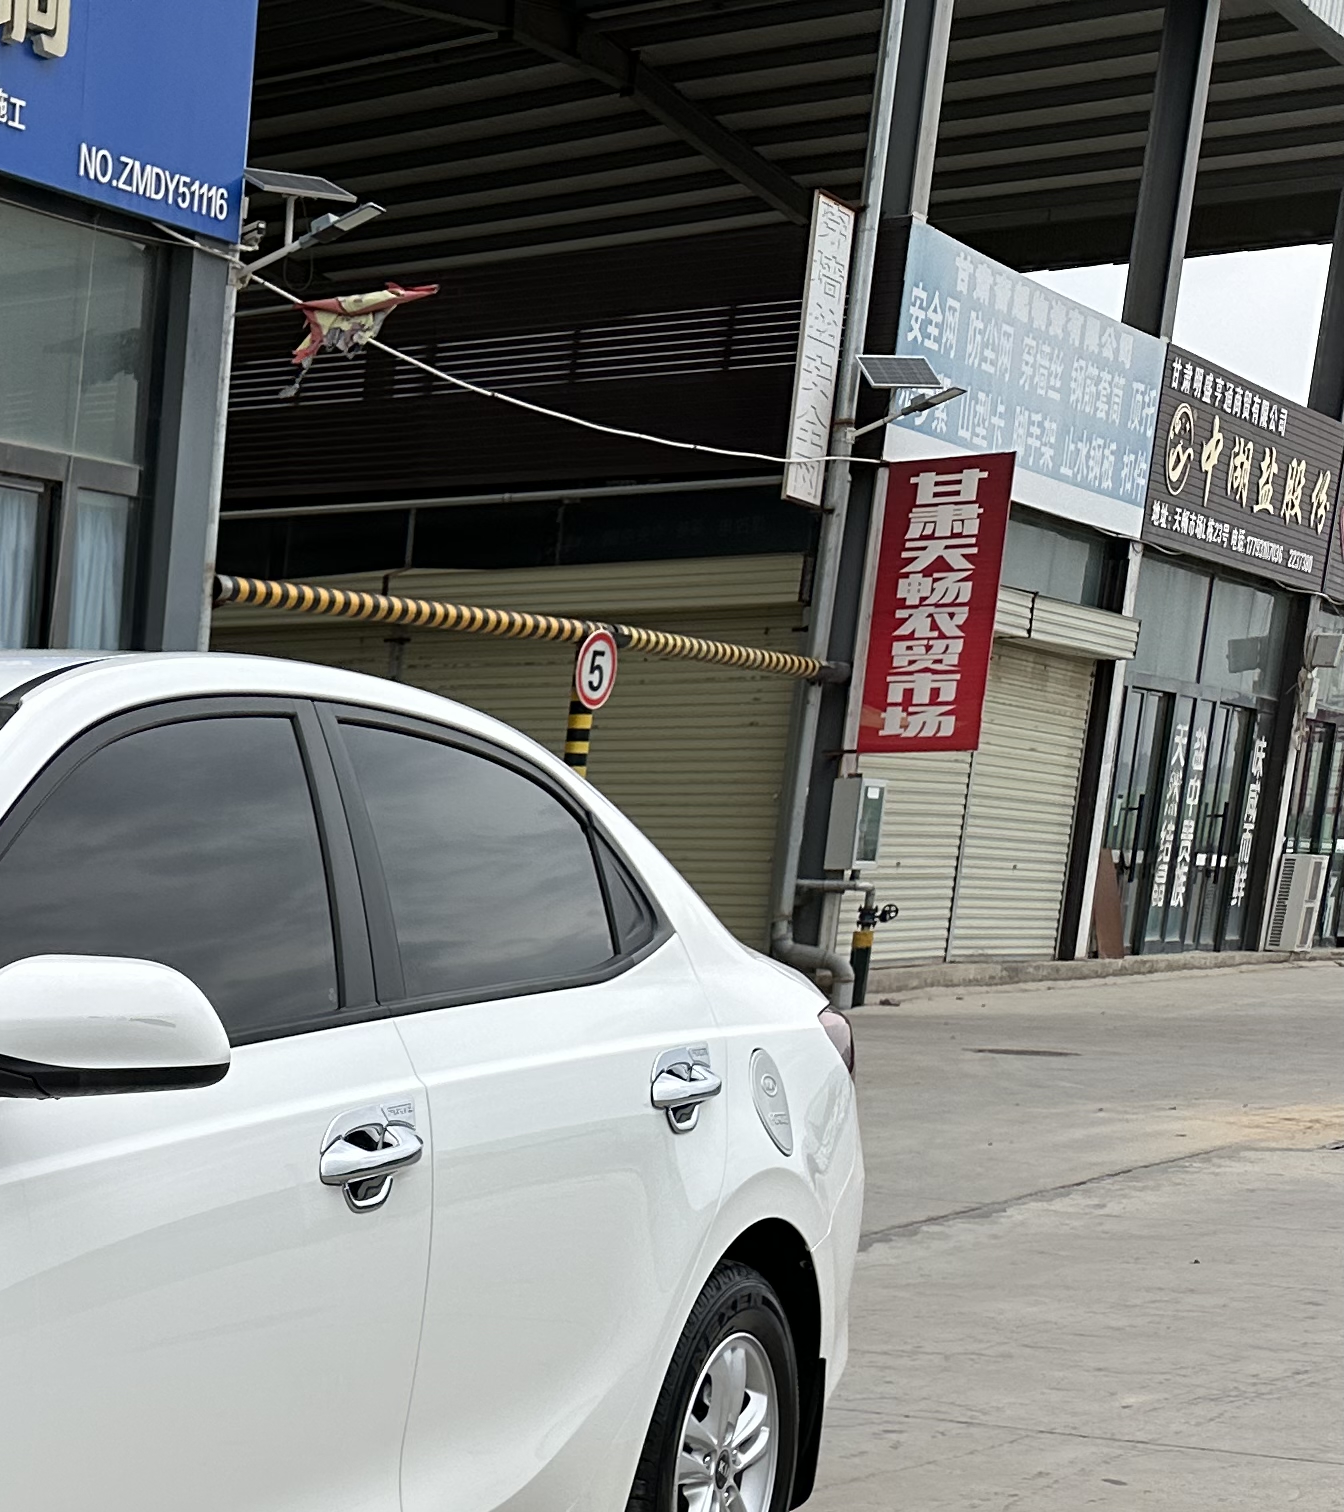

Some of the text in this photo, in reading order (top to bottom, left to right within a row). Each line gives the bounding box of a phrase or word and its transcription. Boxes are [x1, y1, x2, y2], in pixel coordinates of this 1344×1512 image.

[79, 142, 228, 220] NO.ZMDY51116
[907, 282, 1156, 438] 安全网 防尘网 穿墙丝 钢筋套筒 顶托
[958, 385, 1005, 451] 山型卡
[1014, 406, 1058, 472] 脚手架
[1060, 426, 1116, 491] 止水钢板
[1119, 446, 1147, 503] 扣件
[878, 468, 988, 738] 甘肃天畅农贸市场
[588, 649, 605, 692] 5
